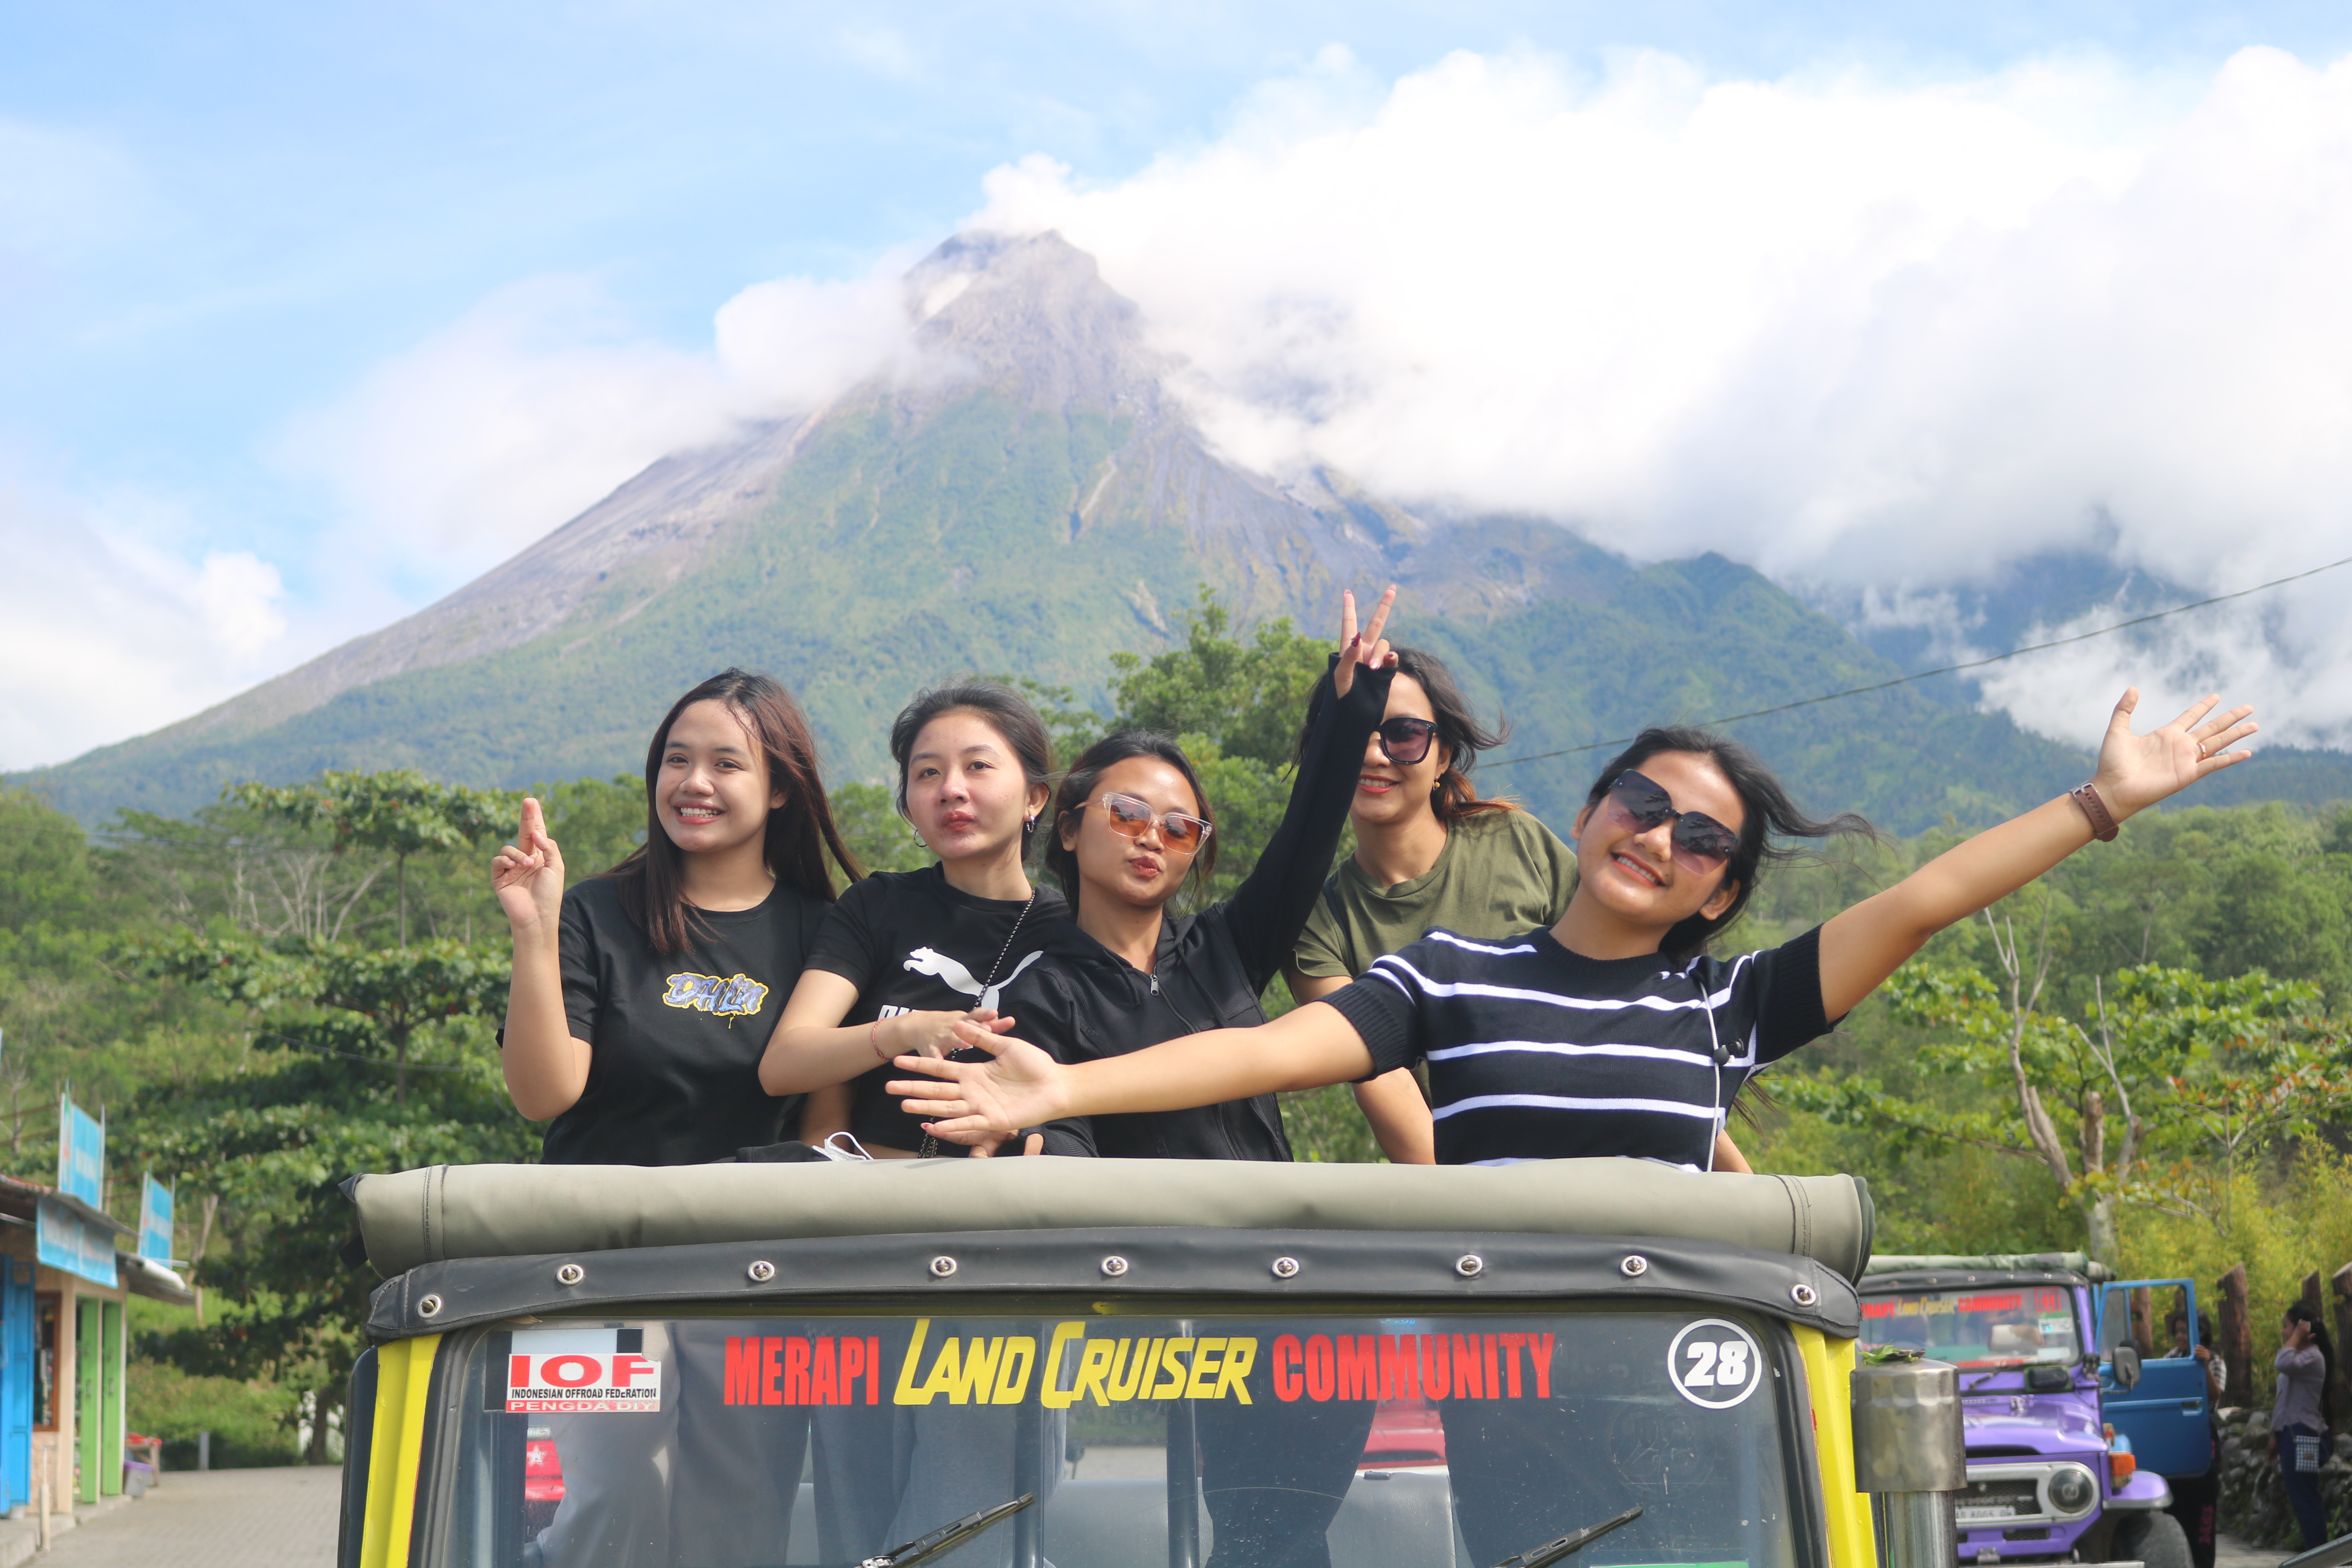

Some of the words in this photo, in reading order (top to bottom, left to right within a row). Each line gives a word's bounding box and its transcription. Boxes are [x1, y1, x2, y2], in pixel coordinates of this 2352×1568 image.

[1860, 1302, 1895, 1318] ERAPI
[1958, 1294, 2022, 1312] COMMUNITY
[2040, 1292, 2056, 1308] 41
[510, 1355, 654, 1388] IOF
[724, 1336, 879, 1405] MERAPI
[893, 1318, 1036, 1405] LAND
[1040, 1321, 1258, 1408] CRUISER
[1273, 1333, 1555, 1402] COMMUNITY
[1684, 1341, 1748, 1387] 28
[512, 1389, 563, 1398] INDONESIAN
[565, 1389, 603, 1398] OFFROAD
[510, 1402, 609, 1411] PENGDA
[617, 1401, 652, 1410] DIY
